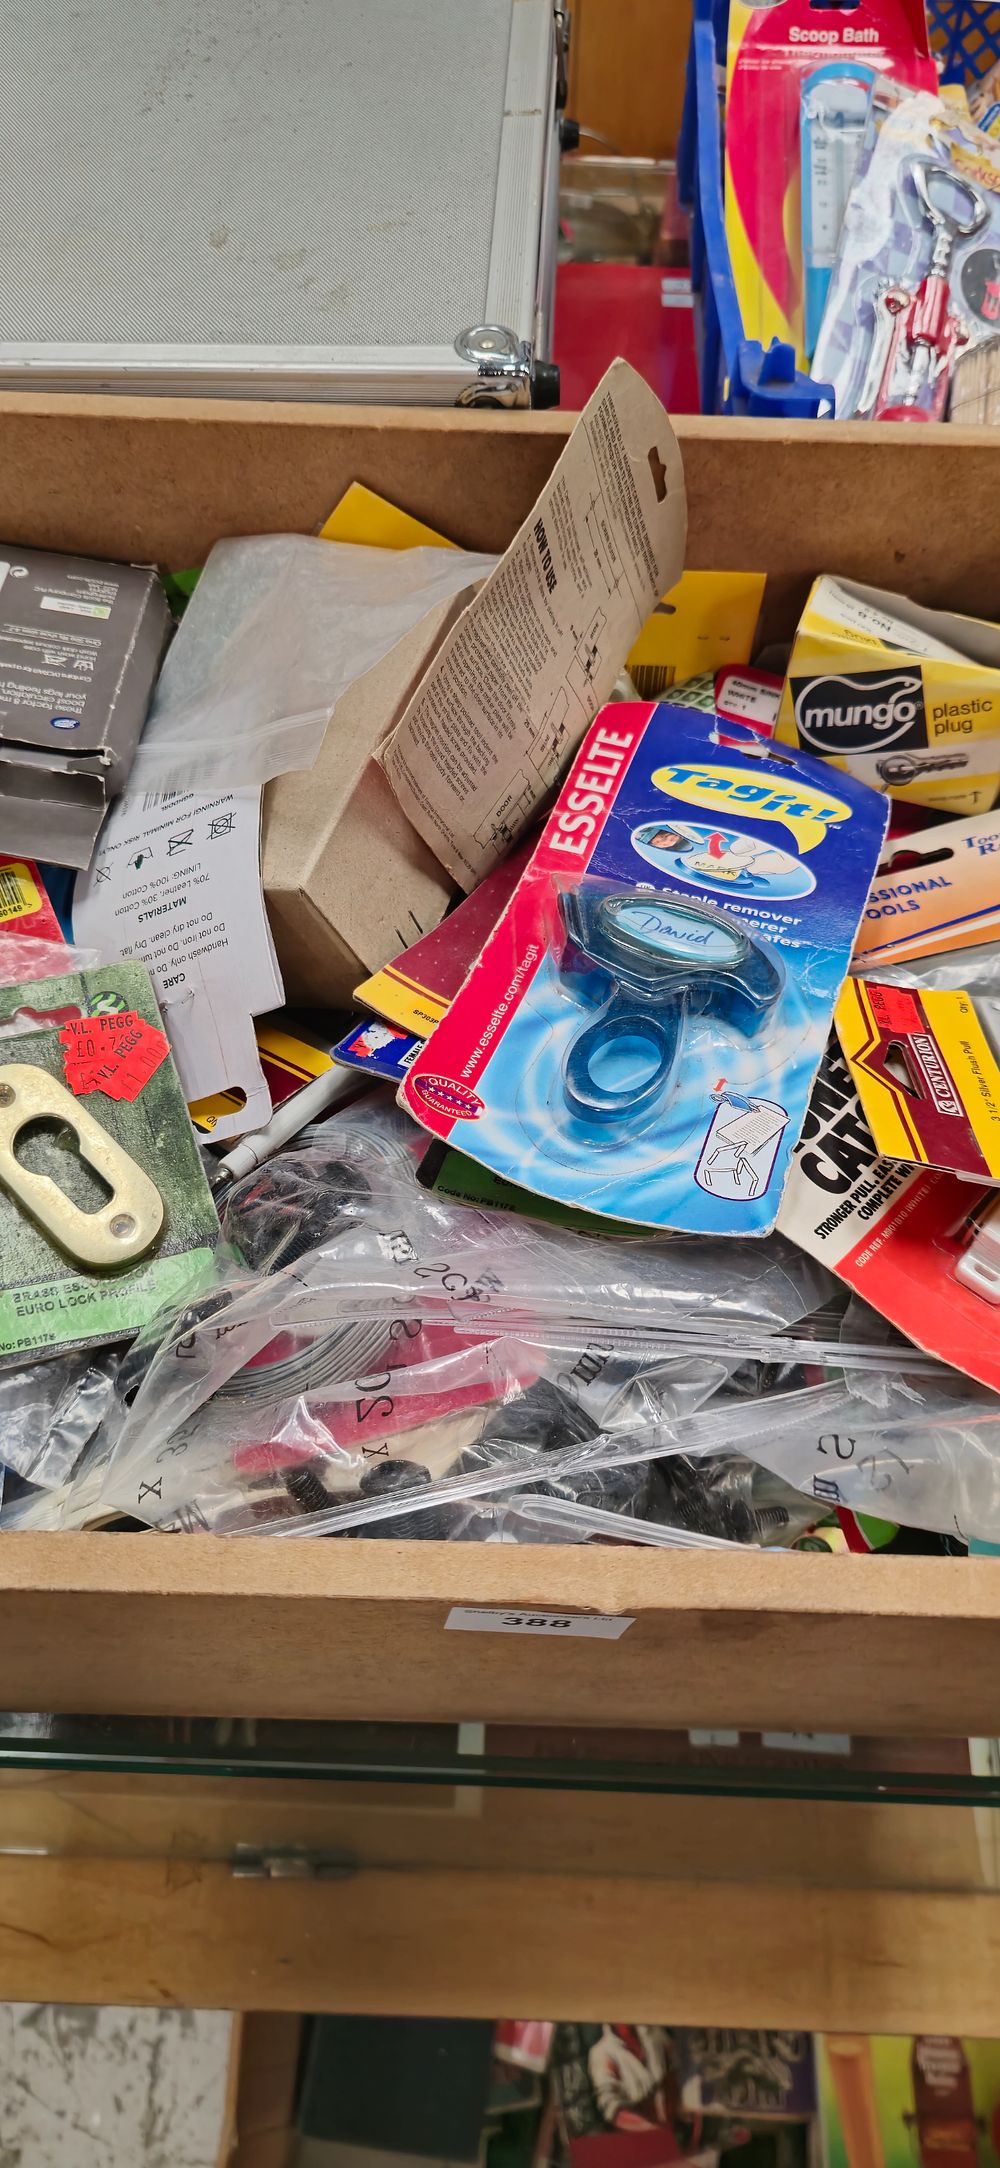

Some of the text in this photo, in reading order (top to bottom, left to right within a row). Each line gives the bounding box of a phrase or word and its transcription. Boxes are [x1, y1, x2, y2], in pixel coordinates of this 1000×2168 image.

[788, 26, 879, 45] Scoop Bath
[533, 517, 558, 594] HOW TO USE
[6, 681, 86, 700] your legs feeling
[55, 697, 85, 706] boost
[21, 699, 52, 709] factor
[55, 704, 81, 713] These
[932, 698, 992, 720] plastic
[460, 705, 475, 729] pointed
[805, 700, 916, 731] mungo
[934, 717, 973, 736] plug
[549, 727, 634, 856] ESSELTE
[666, 766, 842, 822] Tagit!
[193, 794, 234, 818] WARNING!
[142, 821, 176, 839] MINIMAL
[176, 814, 192, 826] FOR
[124, 835, 141, 846] RISK
[961, 830, 1000, 849] TOO
[121, 862, 201, 900] LINING: 100% Cotton
[867, 875, 952, 904] SSIONAL
[113, 873, 210, 917] 70% Leather, 30% Cotton
[137, 896, 187, 922] MATERIALS
[723, 903, 801, 926] remover
[865, 899, 920, 920] OOLS
[119, 912, 213, 957] Do not dry clean. Dry flat.
[198, 928, 212, 940] not
[213, 922, 225, 934] Do
[630, 909, 716, 947] David
[166, 942, 179, 953] Do
[180, 934, 197, 946] iron.
[153, 947, 166, 959] not
[154, 937, 228, 974] Handwash only. Do
[161, 972, 186, 988] CARE
[458, 941, 542, 1081] www.esselte.com/tagit
[70, 1014, 133, 1035] V.L. PEGG
[75, 1032, 125, 1057] £0.7
[97, 1026, 142, 1082] V.L. PEGG
[960, 1038, 973, 1054] Pull
[914, 1035, 951, 1099] CENTURION
[967, 1054, 981, 1075] Flush
[428, 1075, 482, 1107] QUALITY
[975, 1075, 990, 1097] Silver
[420, 1089, 473, 1117] GUARANTEED
[991, 1114, 1000, 1122] 3
[437, 1184, 460, 1196] Code
[814, 1154, 898, 1239] STRONGER PULL. EAS
[856, 1159, 916, 1221] COMPLETE WI
[854, 1248, 873, 1268] CODE
[868, 1234, 885, 1252] REF.
[16, 1279, 158, 1316] EURO LOCK PROFILE
[499, 1615, 572, 1630] 388
